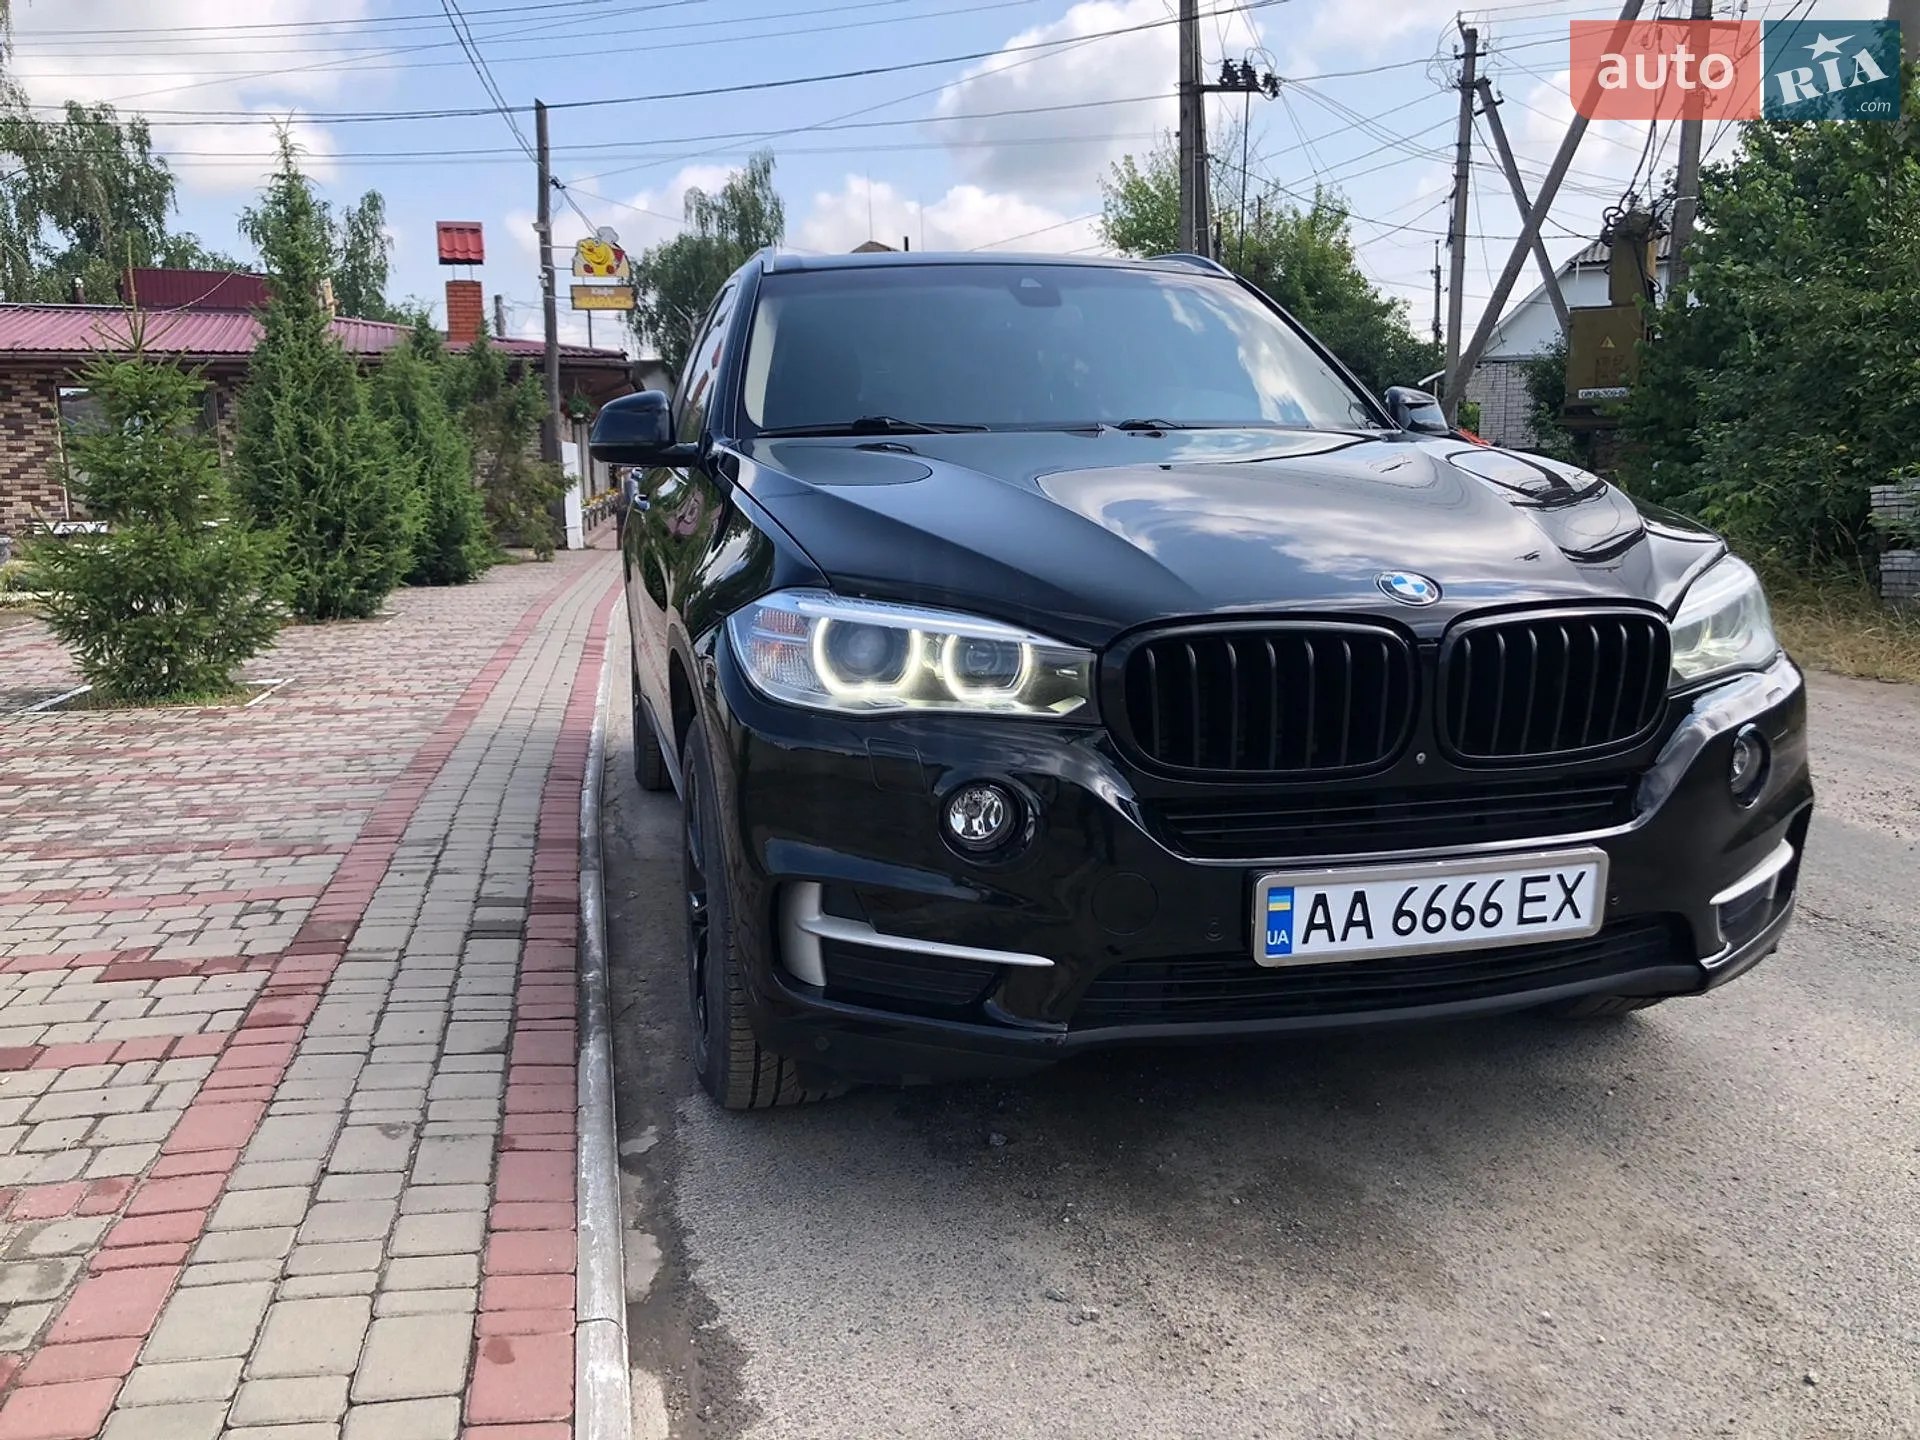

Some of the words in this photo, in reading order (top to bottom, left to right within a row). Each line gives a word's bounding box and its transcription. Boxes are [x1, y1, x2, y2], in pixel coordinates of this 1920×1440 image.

[1301, 890, 1374, 945] AA
[1391, 879, 1505, 936] 6666
[1517, 871, 1587, 926] EX
[1266, 929, 1289, 946] UA
